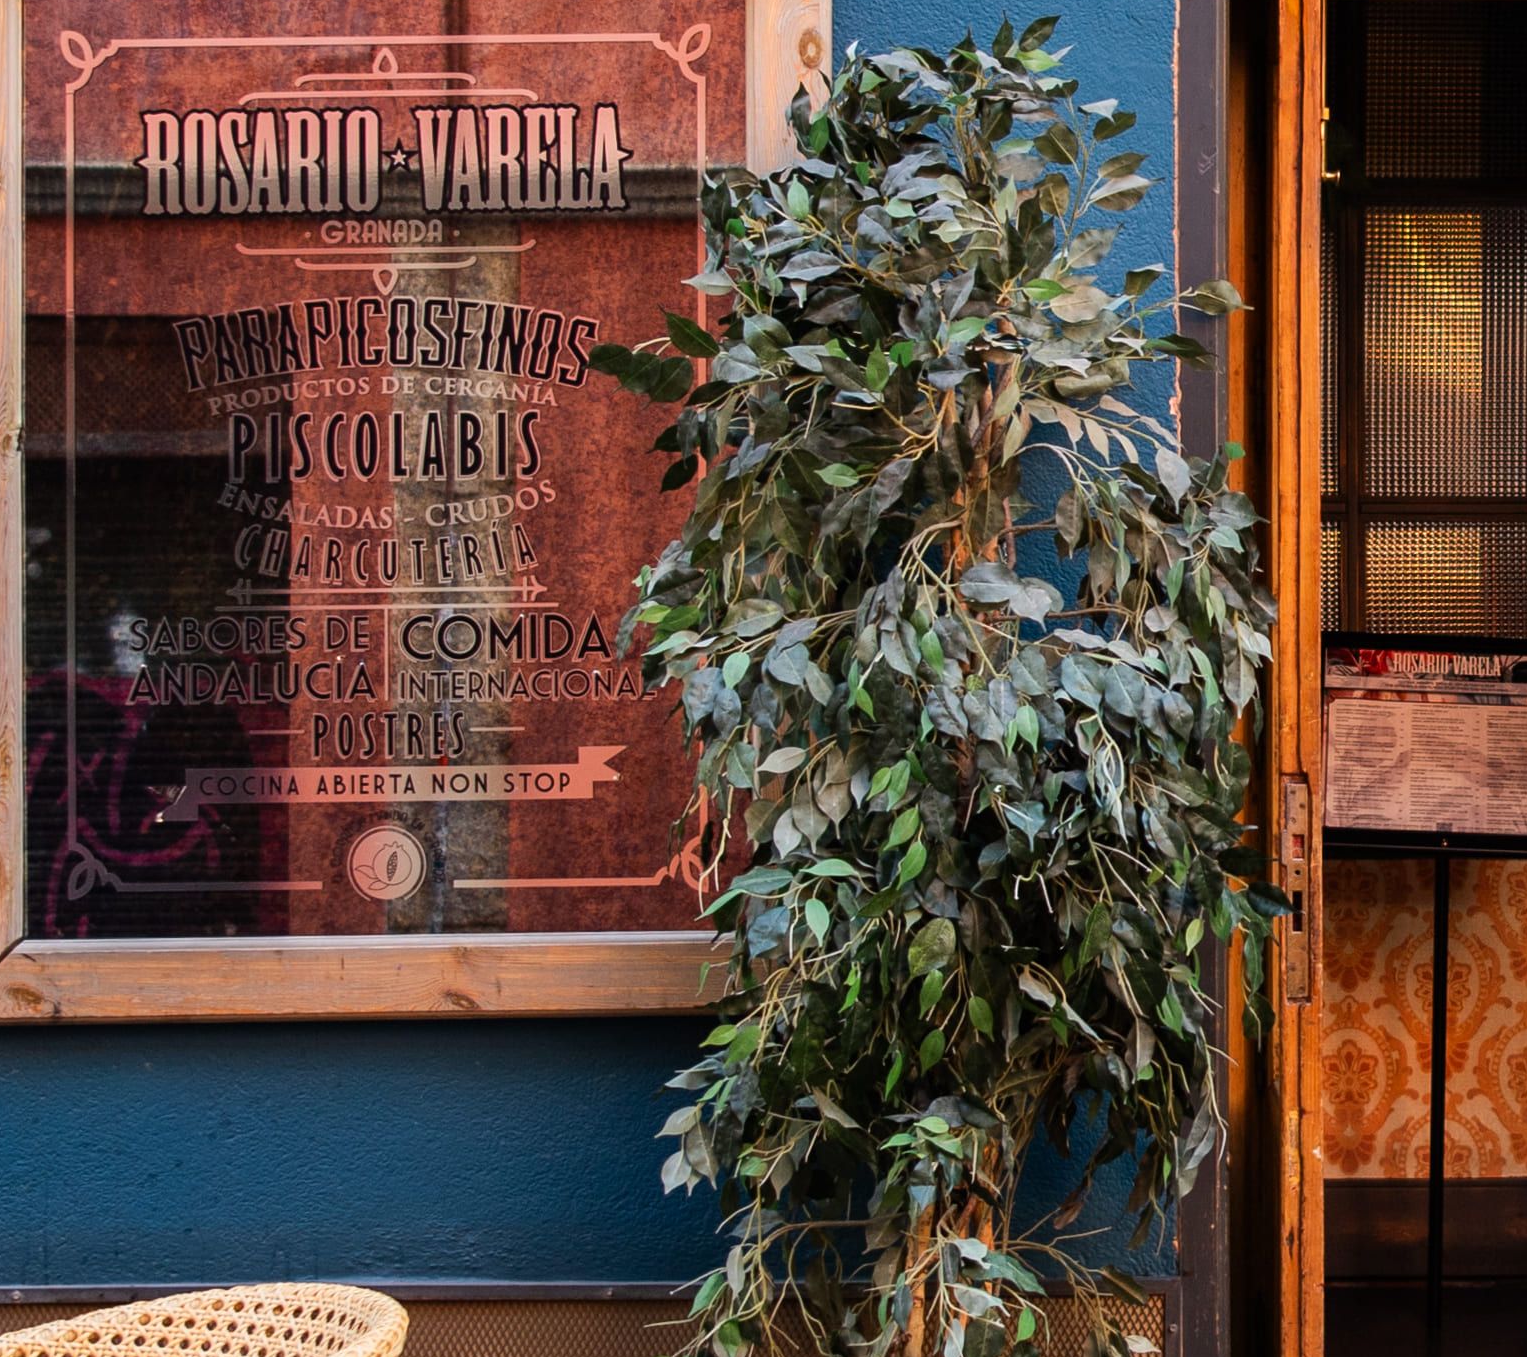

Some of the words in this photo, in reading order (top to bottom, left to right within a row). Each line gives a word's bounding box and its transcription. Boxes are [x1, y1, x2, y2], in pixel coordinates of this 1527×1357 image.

[136, 108, 381, 216] ROSARIO
[412, 103, 634, 212] VARELA
[321, 220, 442, 244] GRANADA
[174, 296, 600, 392] PARAPICOSFINOS
[207, 377, 370, 418] PRODUCTOS
[381, 376, 415, 395] DE
[424, 376, 559, 407] CERCANÍA
[228, 410, 541, 483] PISCOLABIS
[217, 483, 393, 530] ENSALADAS
[424, 479, 557, 527] CRUDOS
[234, 519, 539, 585] CHARCUTERÍA
[129, 617, 306, 655] SABORES
[324, 614, 370, 652] DE
[399, 610, 614, 663] COMIDA
[125, 655, 378, 705] ANDALUCÍA
[1393, 652, 1449, 674] ROSARIO
[1452, 654, 1501, 676] VARELA
[312, 712, 465, 760] POSTRES
[199, 774, 300, 797] COCINA
[316, 773, 416, 795] ABIERTA
[431, 772, 488, 794] NON
[502, 771, 571, 793] STOP
